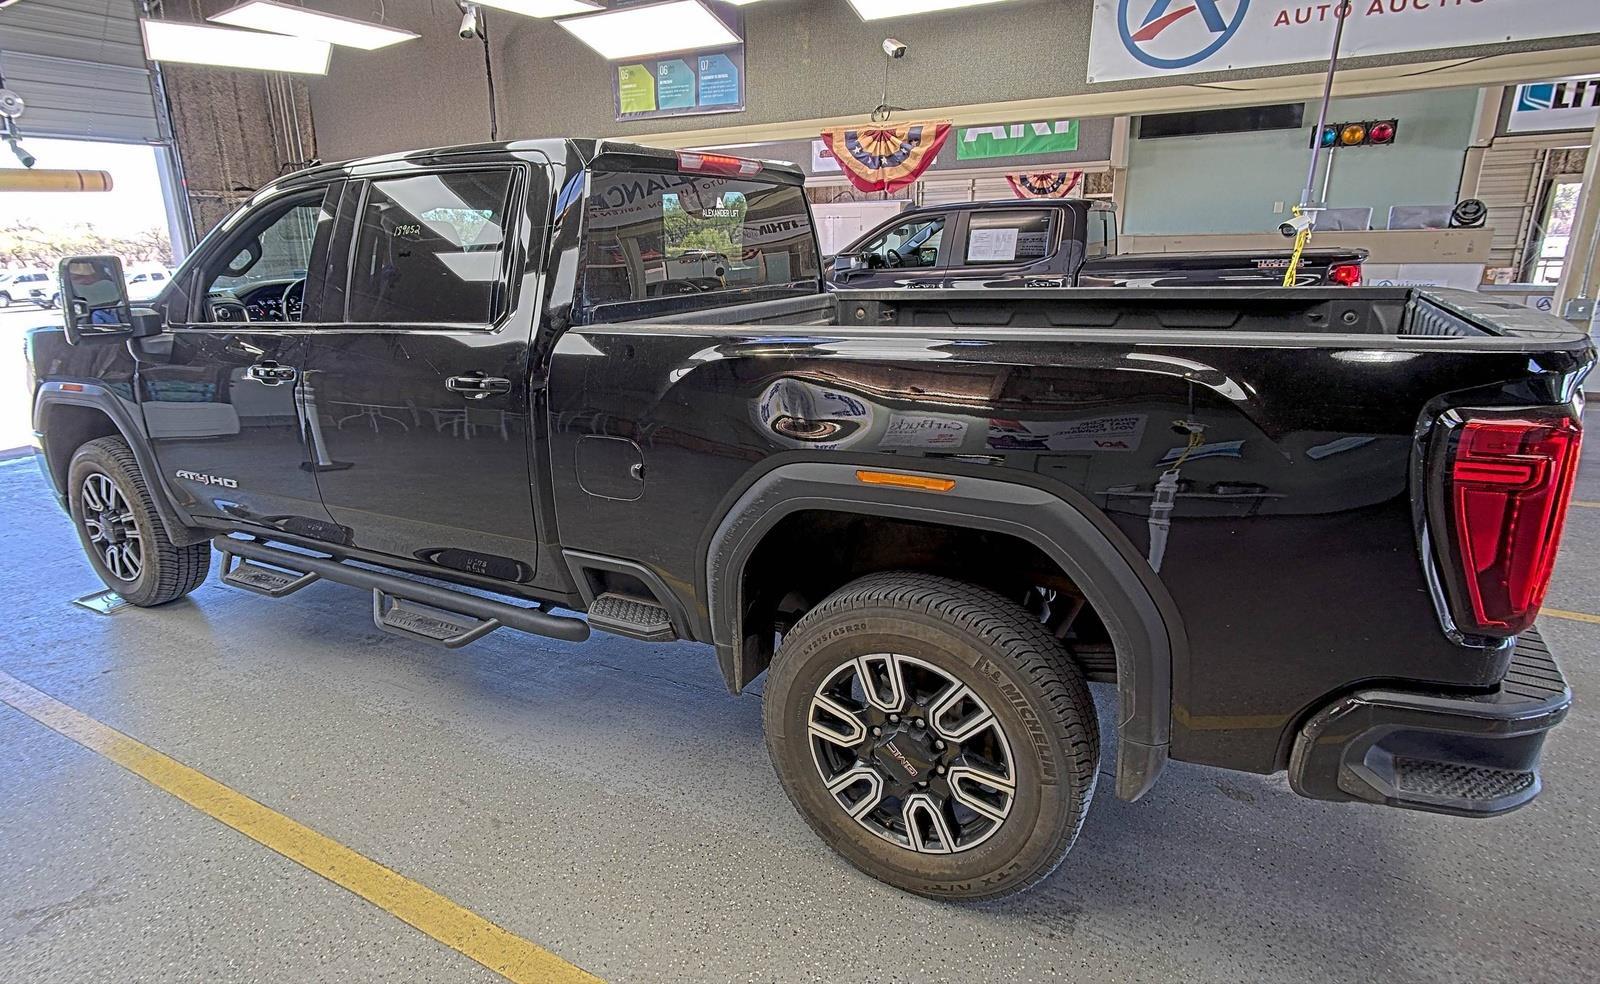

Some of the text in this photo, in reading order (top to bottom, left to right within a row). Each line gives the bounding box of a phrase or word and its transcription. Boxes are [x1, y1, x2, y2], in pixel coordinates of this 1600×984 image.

[1274, 3, 1352, 27] AUTO
[702, 208, 730, 217] ALEXANDER
[175, 469, 238, 488] AT4 HD
[1000, 683, 1058, 780] MICHELIN
[886, 741, 918, 777] GMC
